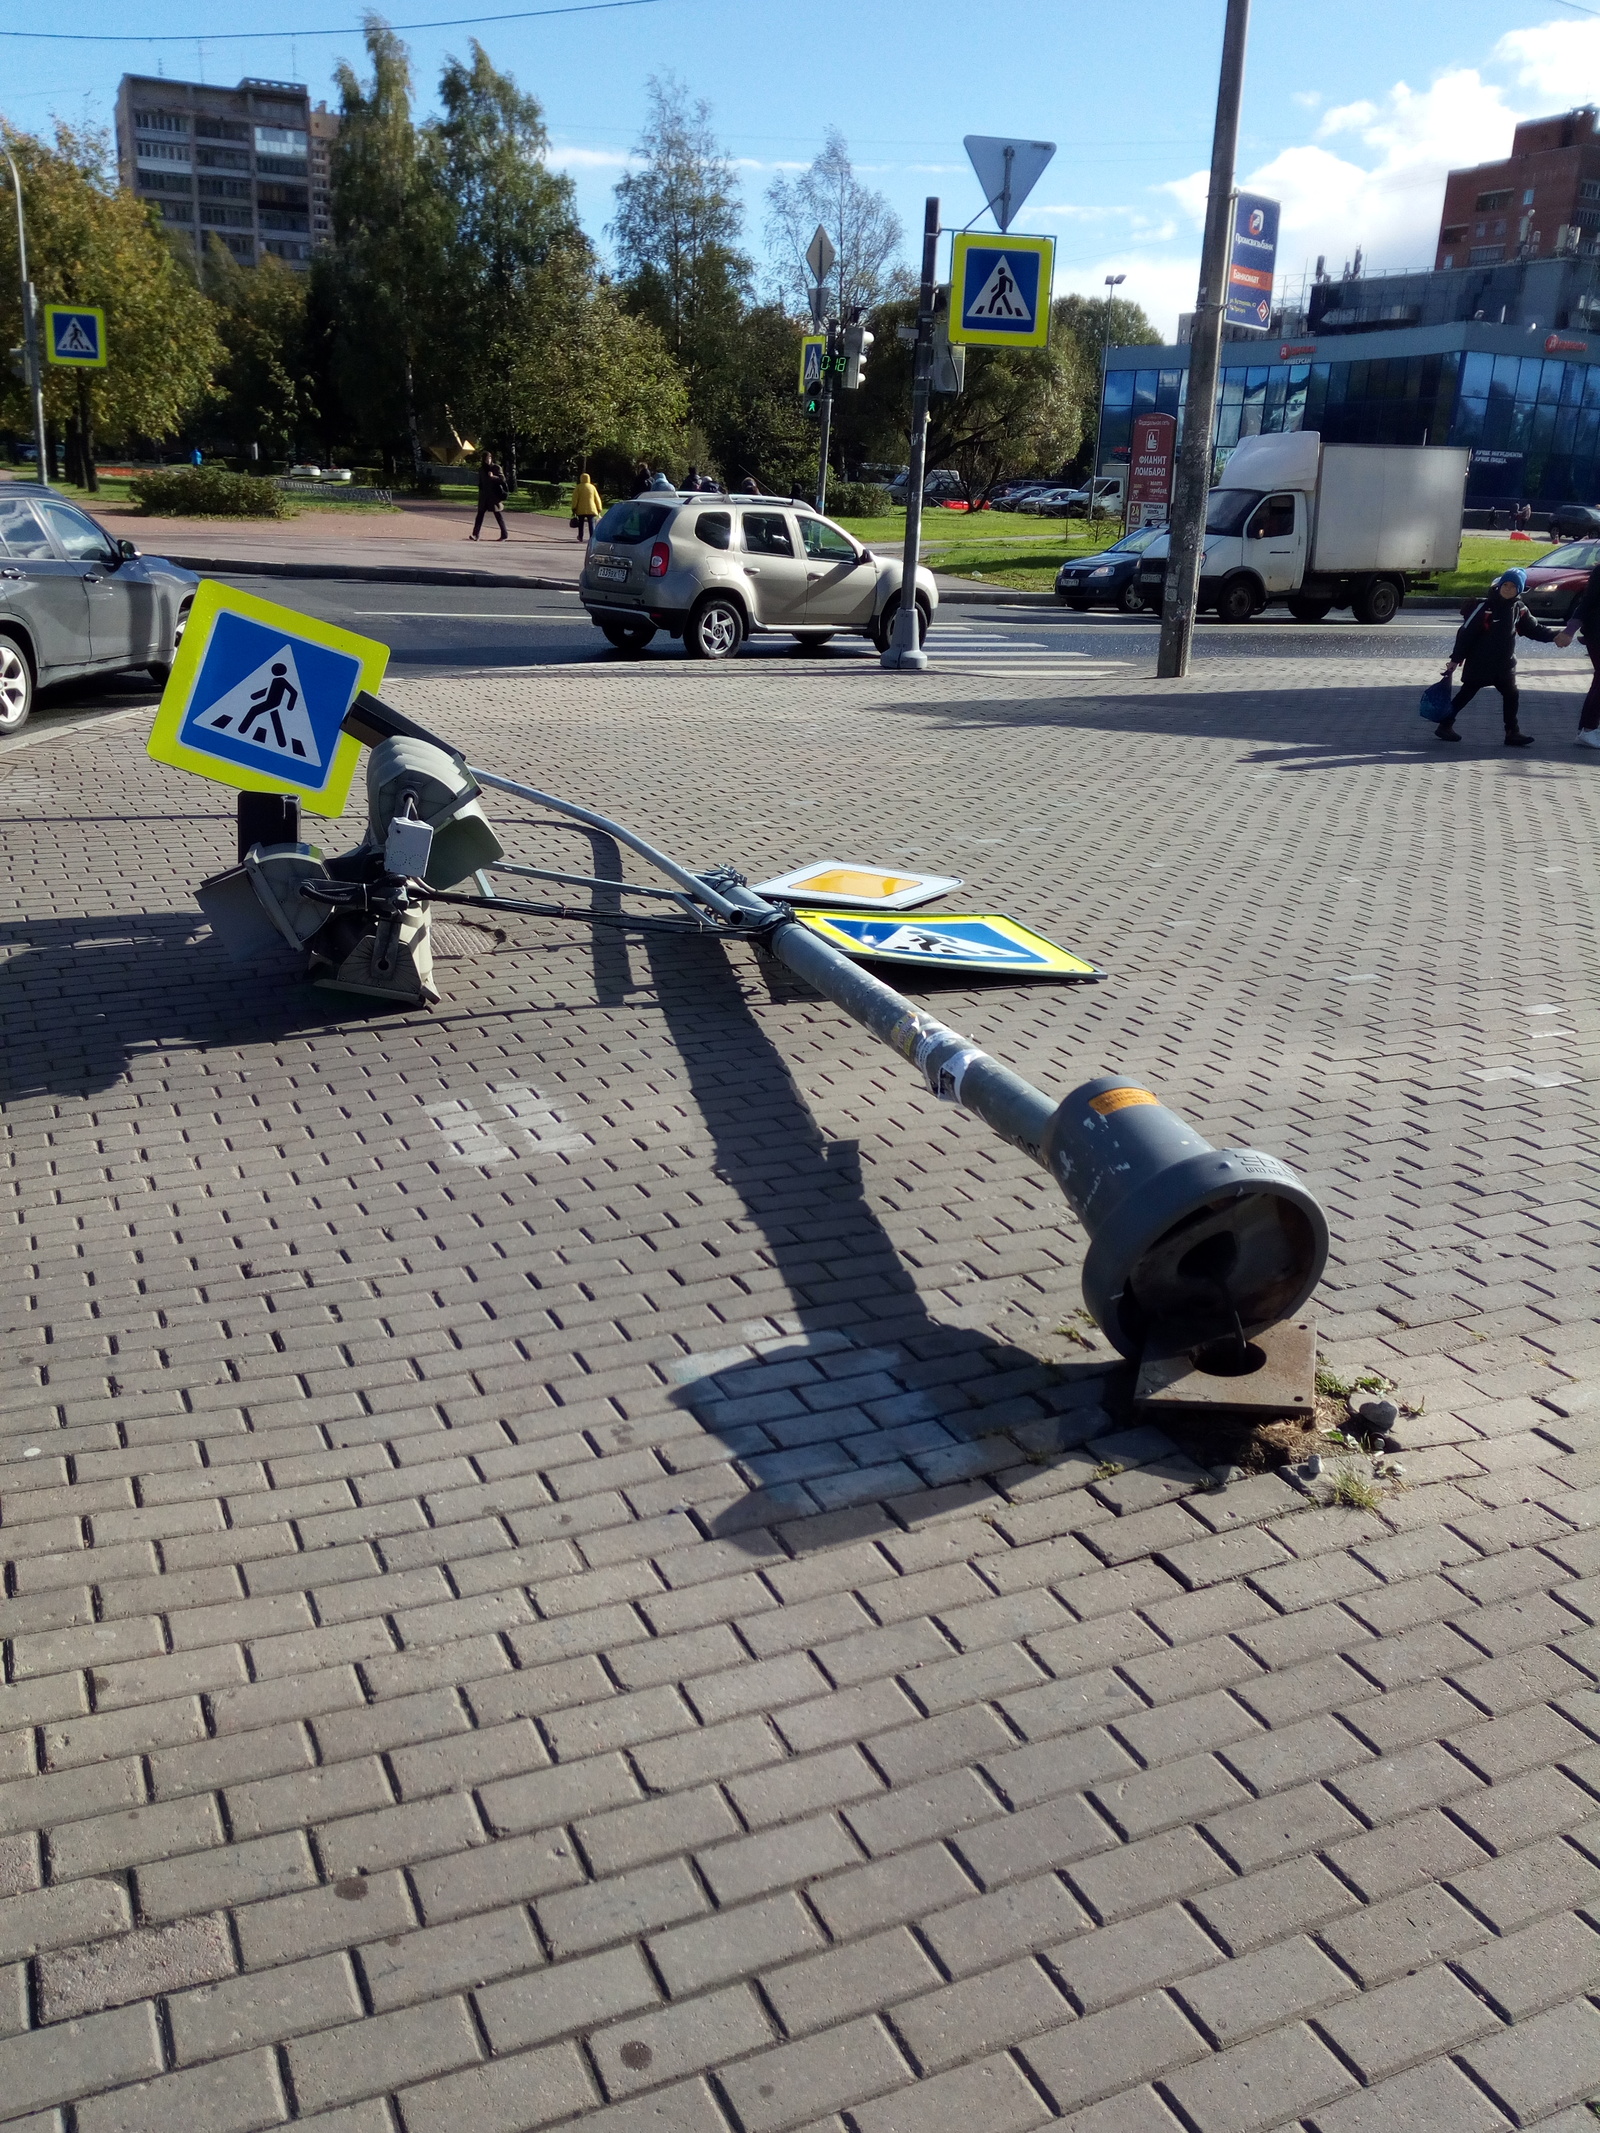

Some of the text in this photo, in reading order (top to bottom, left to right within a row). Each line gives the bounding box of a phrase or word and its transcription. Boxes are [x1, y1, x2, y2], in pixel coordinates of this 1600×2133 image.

[1235, 232, 1274, 251] Промсвязьбанк
[1233, 268, 1260, 284] Банкомат
[1139, 456, 1167, 465] ФИАНИТ
[1134, 467, 1166, 476] ЛОМБАРД
[1131, 505, 1140, 517] 24
